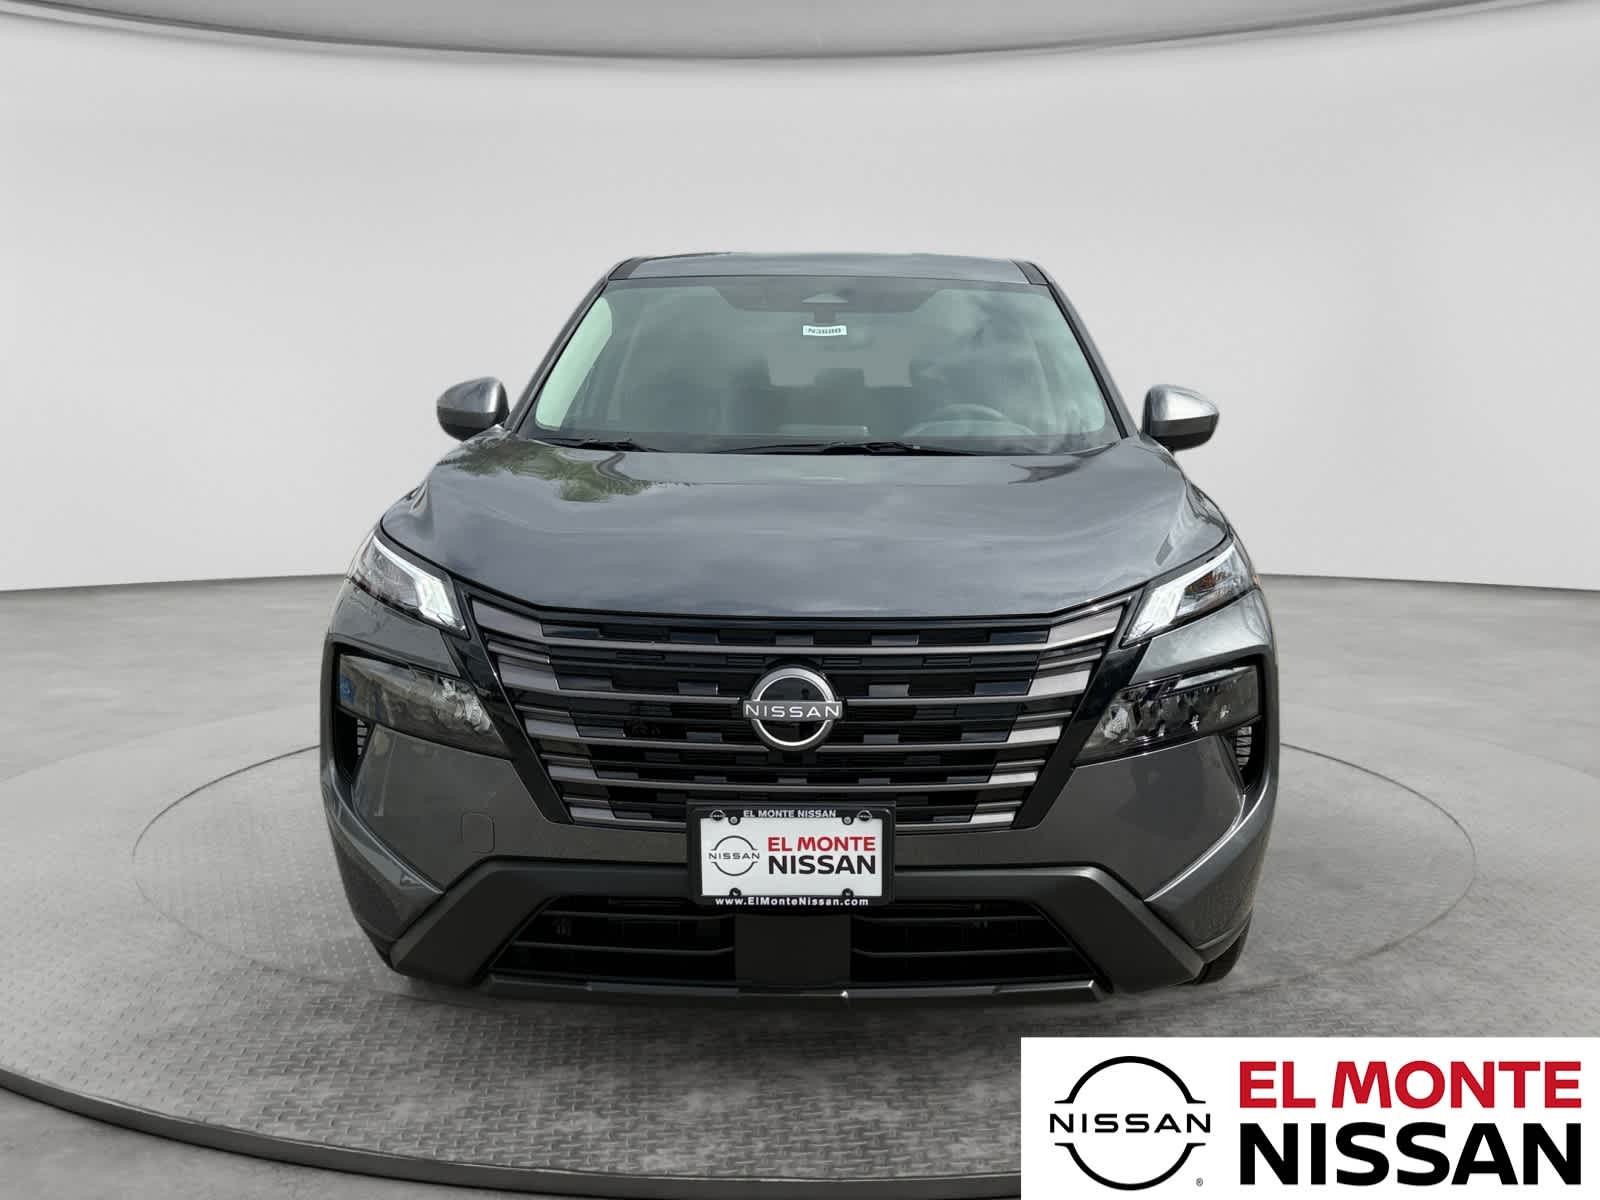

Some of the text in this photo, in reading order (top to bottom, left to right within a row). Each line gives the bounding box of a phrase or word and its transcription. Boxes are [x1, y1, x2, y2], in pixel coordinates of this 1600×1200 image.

[745, 704, 840, 718] NISSAN
[743, 809, 837, 818] EL MONTE NISSAN
[767, 836, 876, 852] EL MONTE
[708, 852, 760, 860] NISSAN
[768, 855, 876, 875] NISSAN
[715, 897, 869, 906] www.ElMonteNissan.com
